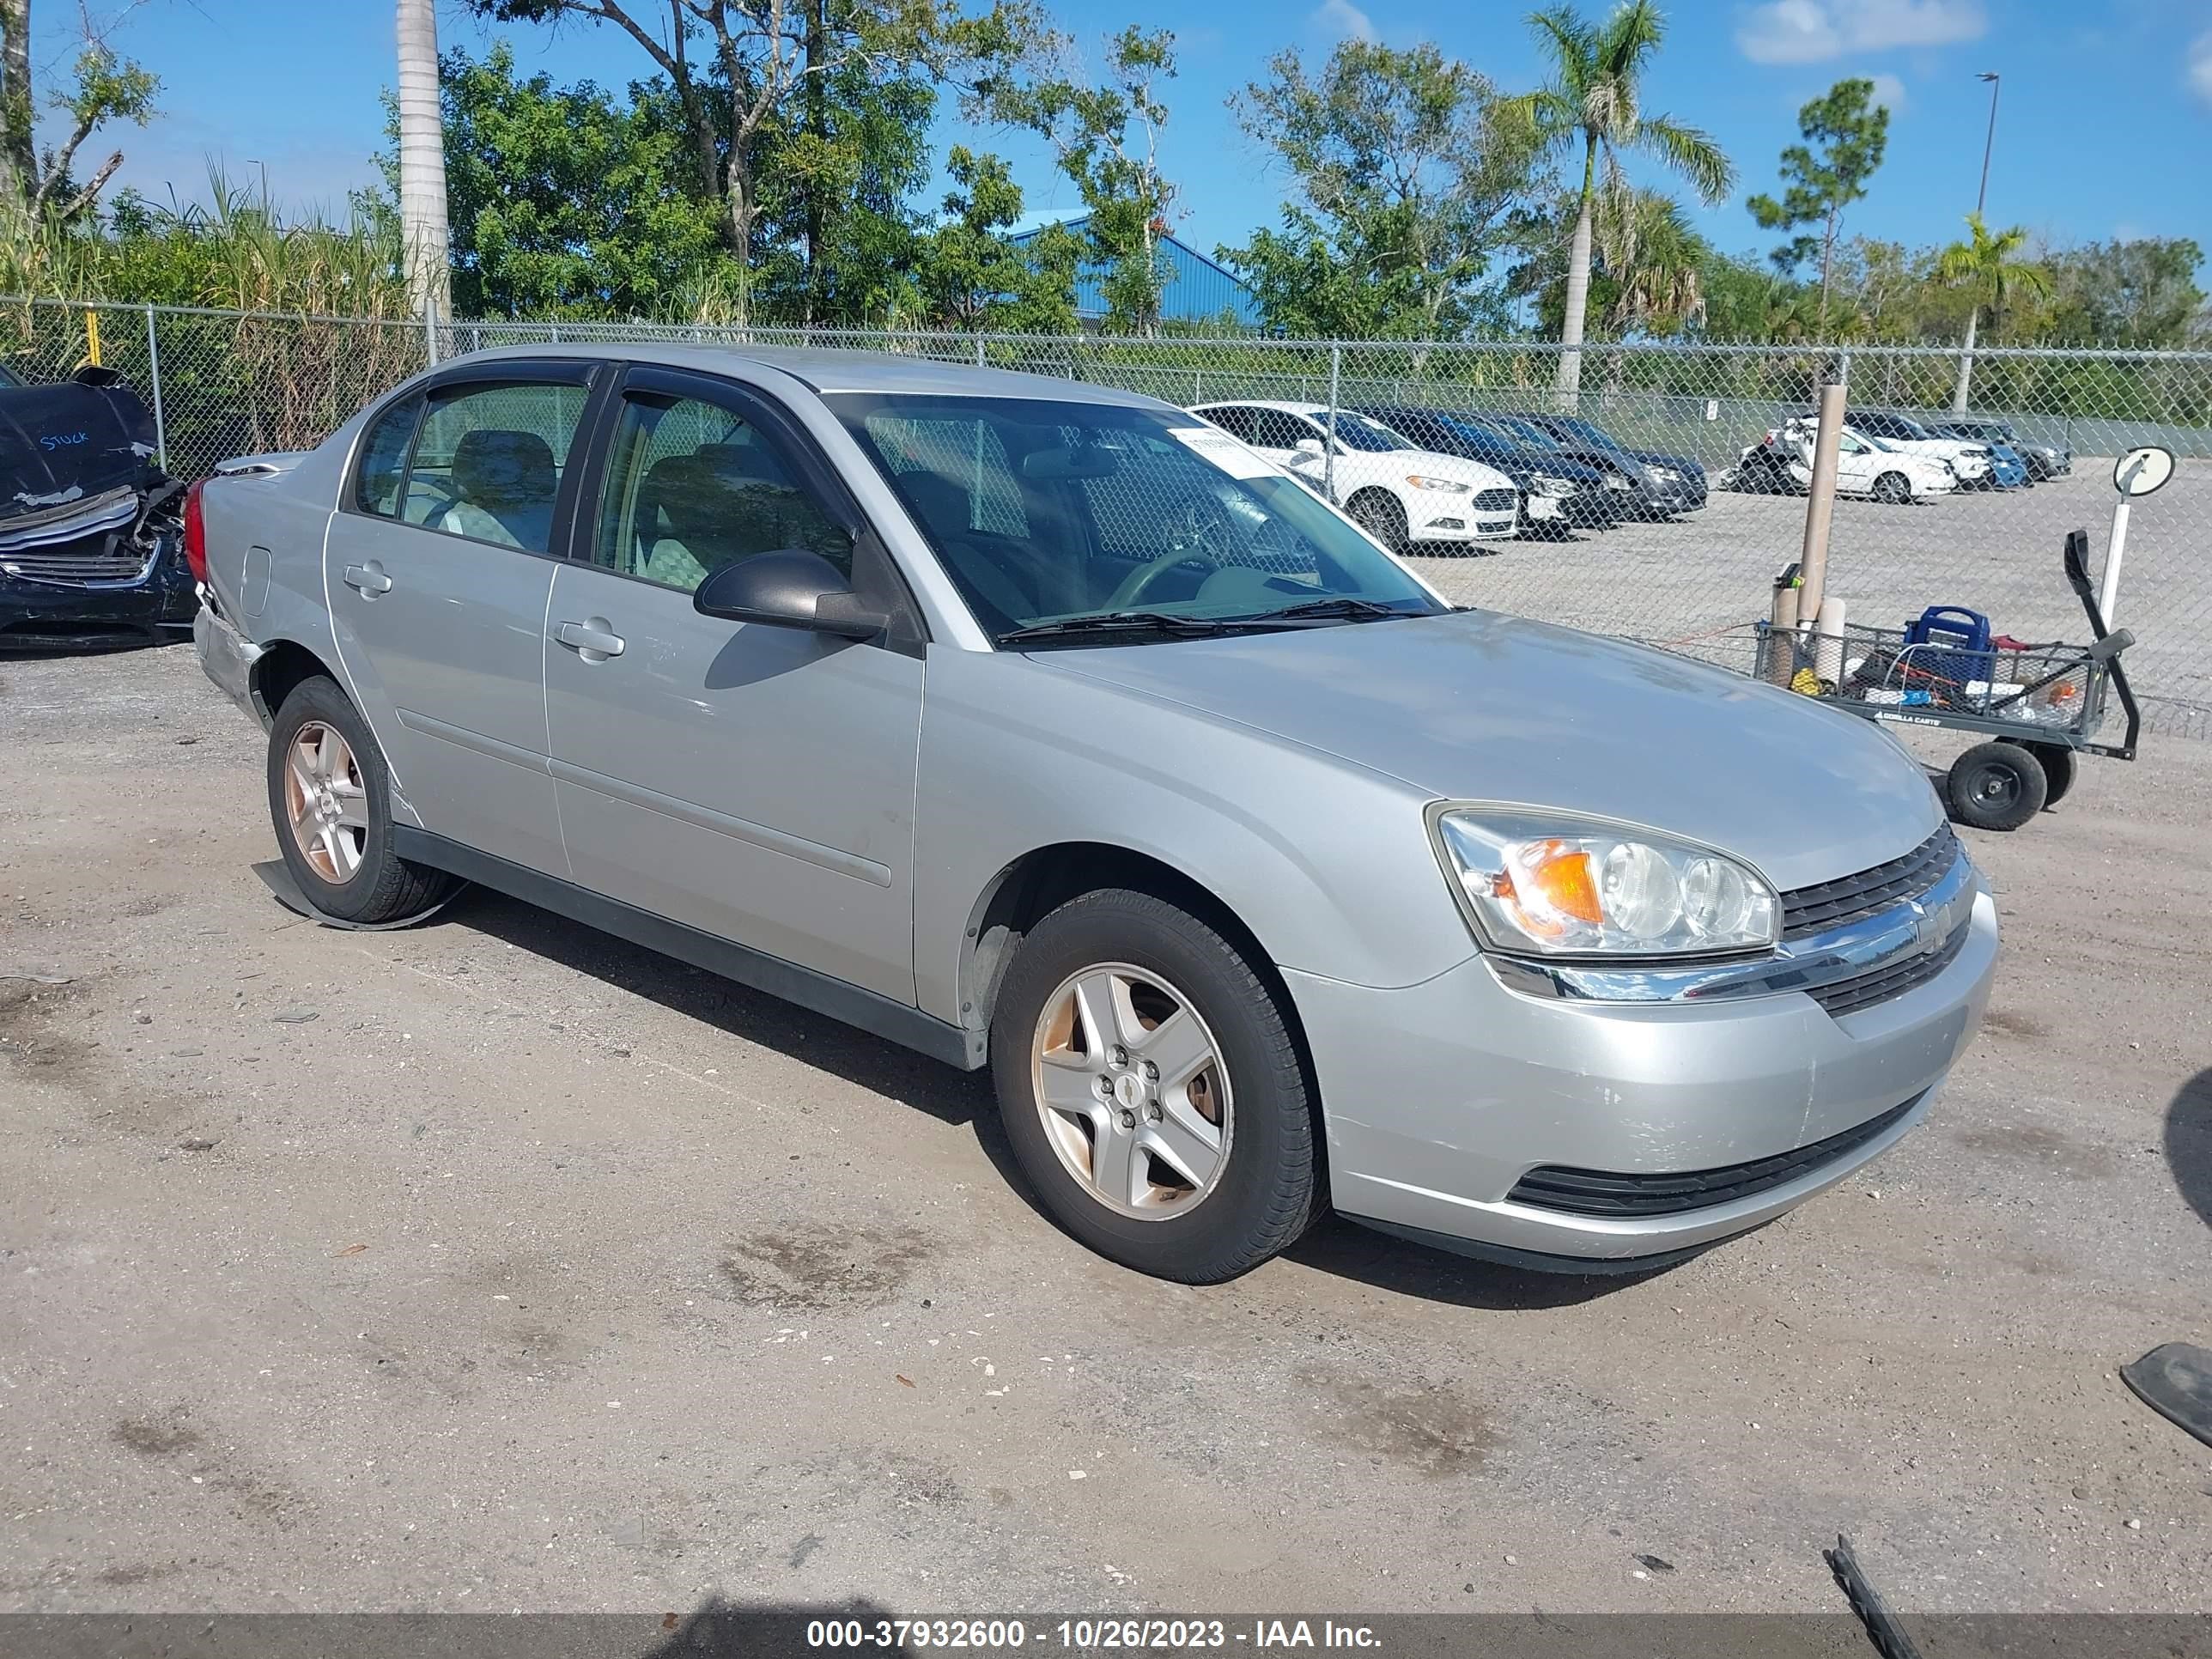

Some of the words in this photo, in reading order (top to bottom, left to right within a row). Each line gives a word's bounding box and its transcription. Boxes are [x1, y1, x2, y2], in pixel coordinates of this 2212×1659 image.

[40, 431, 89, 452] STUCK
[1883, 712, 1913, 723] GORILLA
[1914, 717, 1941, 726] CARTS
